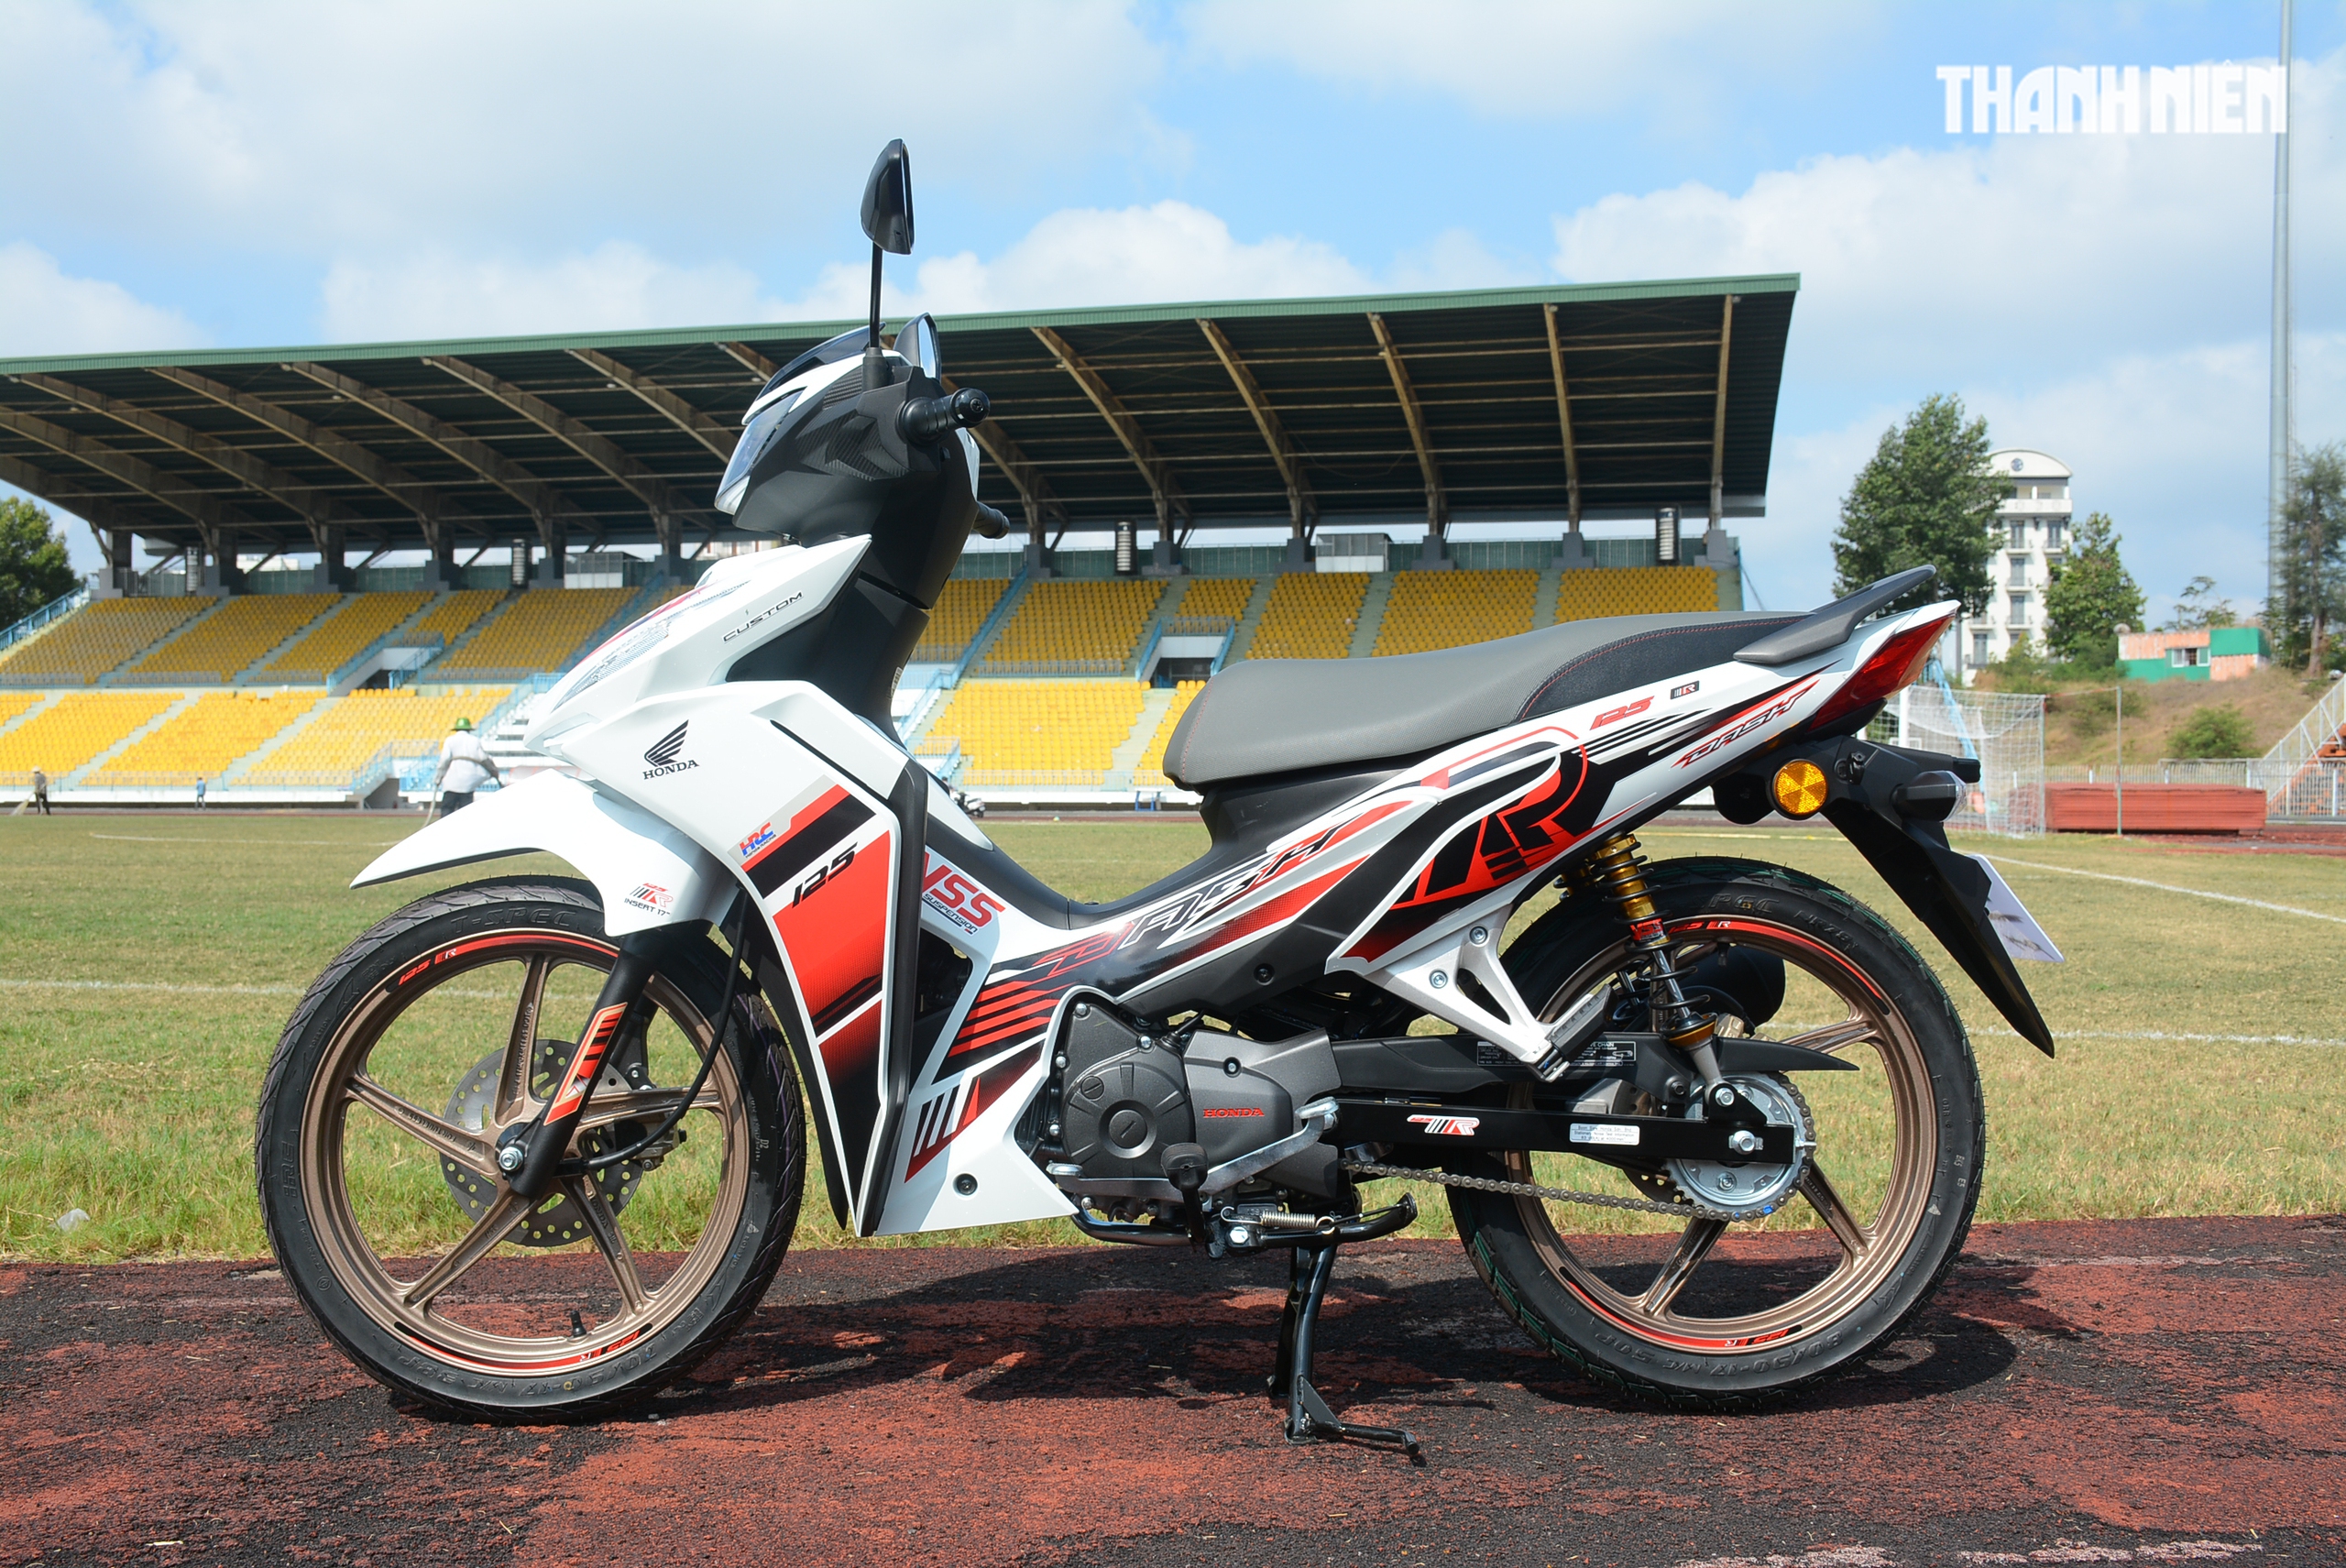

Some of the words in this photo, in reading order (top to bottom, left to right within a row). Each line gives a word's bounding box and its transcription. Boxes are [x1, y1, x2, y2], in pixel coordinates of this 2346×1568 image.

[723, 591, 803, 642] CUSTOM
[1589, 696, 1655, 731] 125
[1673, 679, 1820, 768] DASH
[641, 759, 700, 780] HONDA
[739, 821, 774, 857] HRC
[792, 840, 859, 909] 125
[624, 897, 656, 913] INSERT
[398, 959, 431, 985] 125
[1202, 1106, 1265, 1118] HONDA
[606, 1330, 641, 1352] 125
[1749, 1328, 1790, 1345] 125
